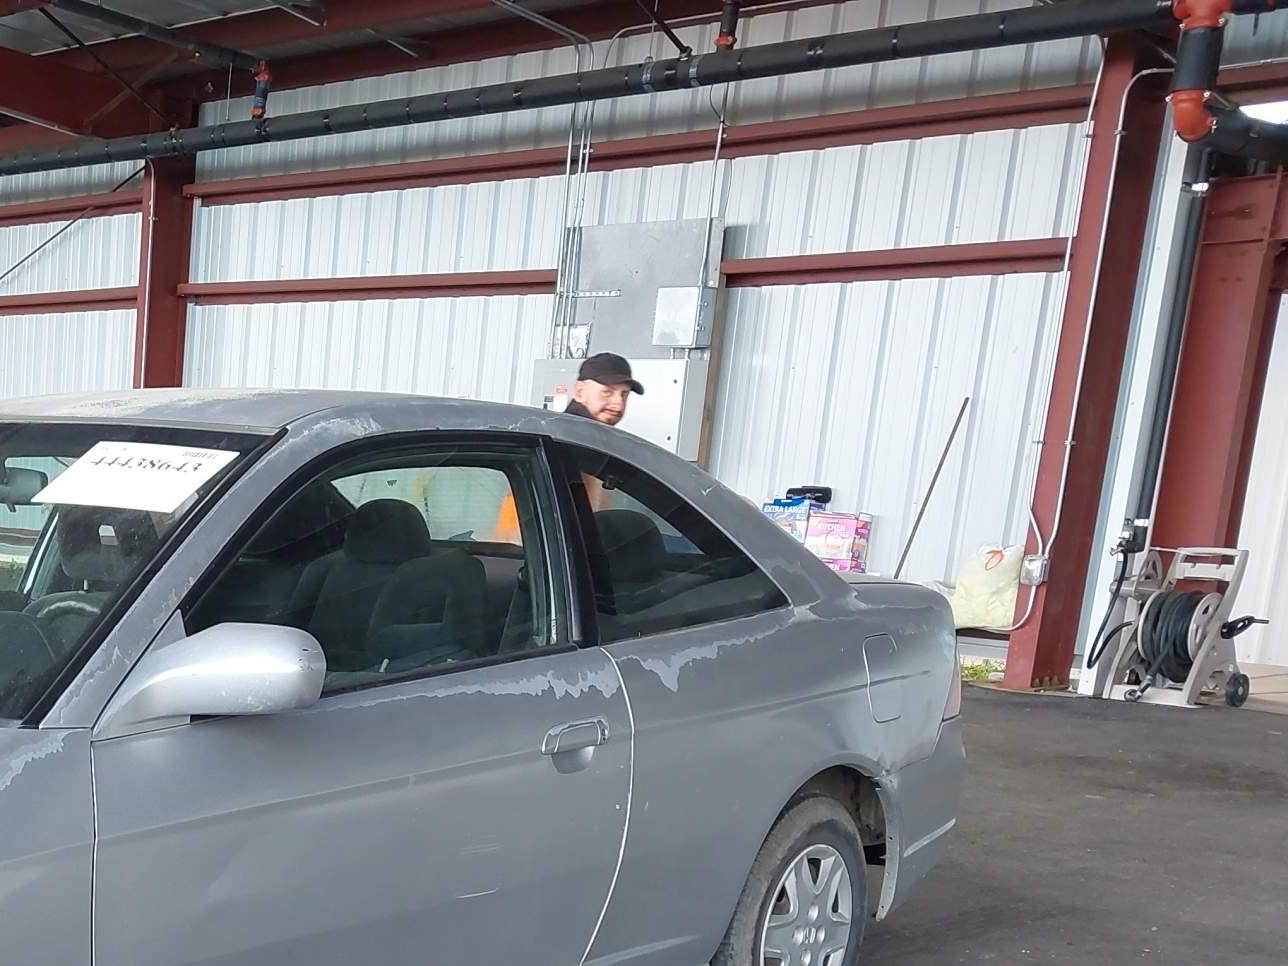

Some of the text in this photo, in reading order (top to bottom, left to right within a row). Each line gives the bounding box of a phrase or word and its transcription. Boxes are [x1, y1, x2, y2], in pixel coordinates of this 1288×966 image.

[764, 505, 806, 514] EXTRA LARGE
[817, 523, 846, 531] KITCHEN
